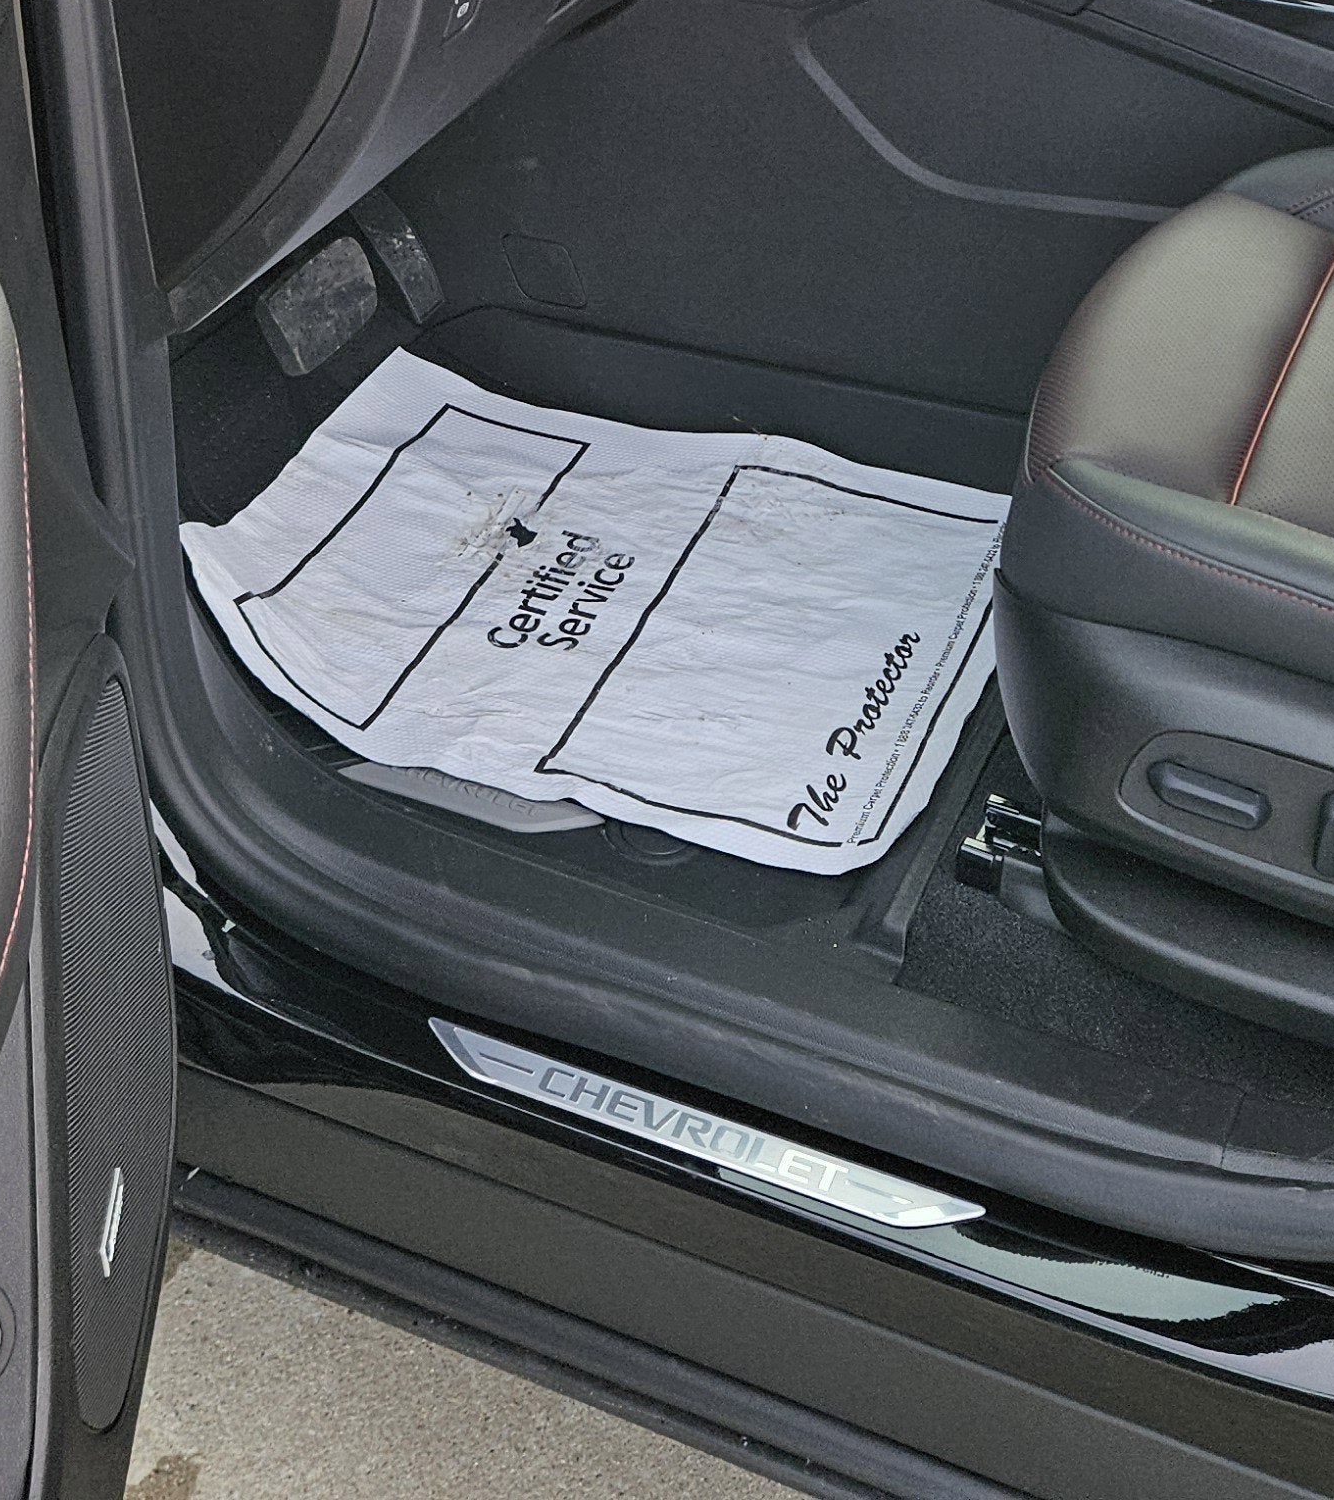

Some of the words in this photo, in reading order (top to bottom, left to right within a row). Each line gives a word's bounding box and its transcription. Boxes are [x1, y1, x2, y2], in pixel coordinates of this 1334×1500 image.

[487, 530, 600, 648] Certified
[537, 553, 635, 651] Service
[787, 773, 847, 831] The
[826, 632, 920, 760] Protector
[847, 809, 870, 846] Premium
[875, 751, 899, 790] Protection
[538, 1066, 849, 1194] CHEVROLET
